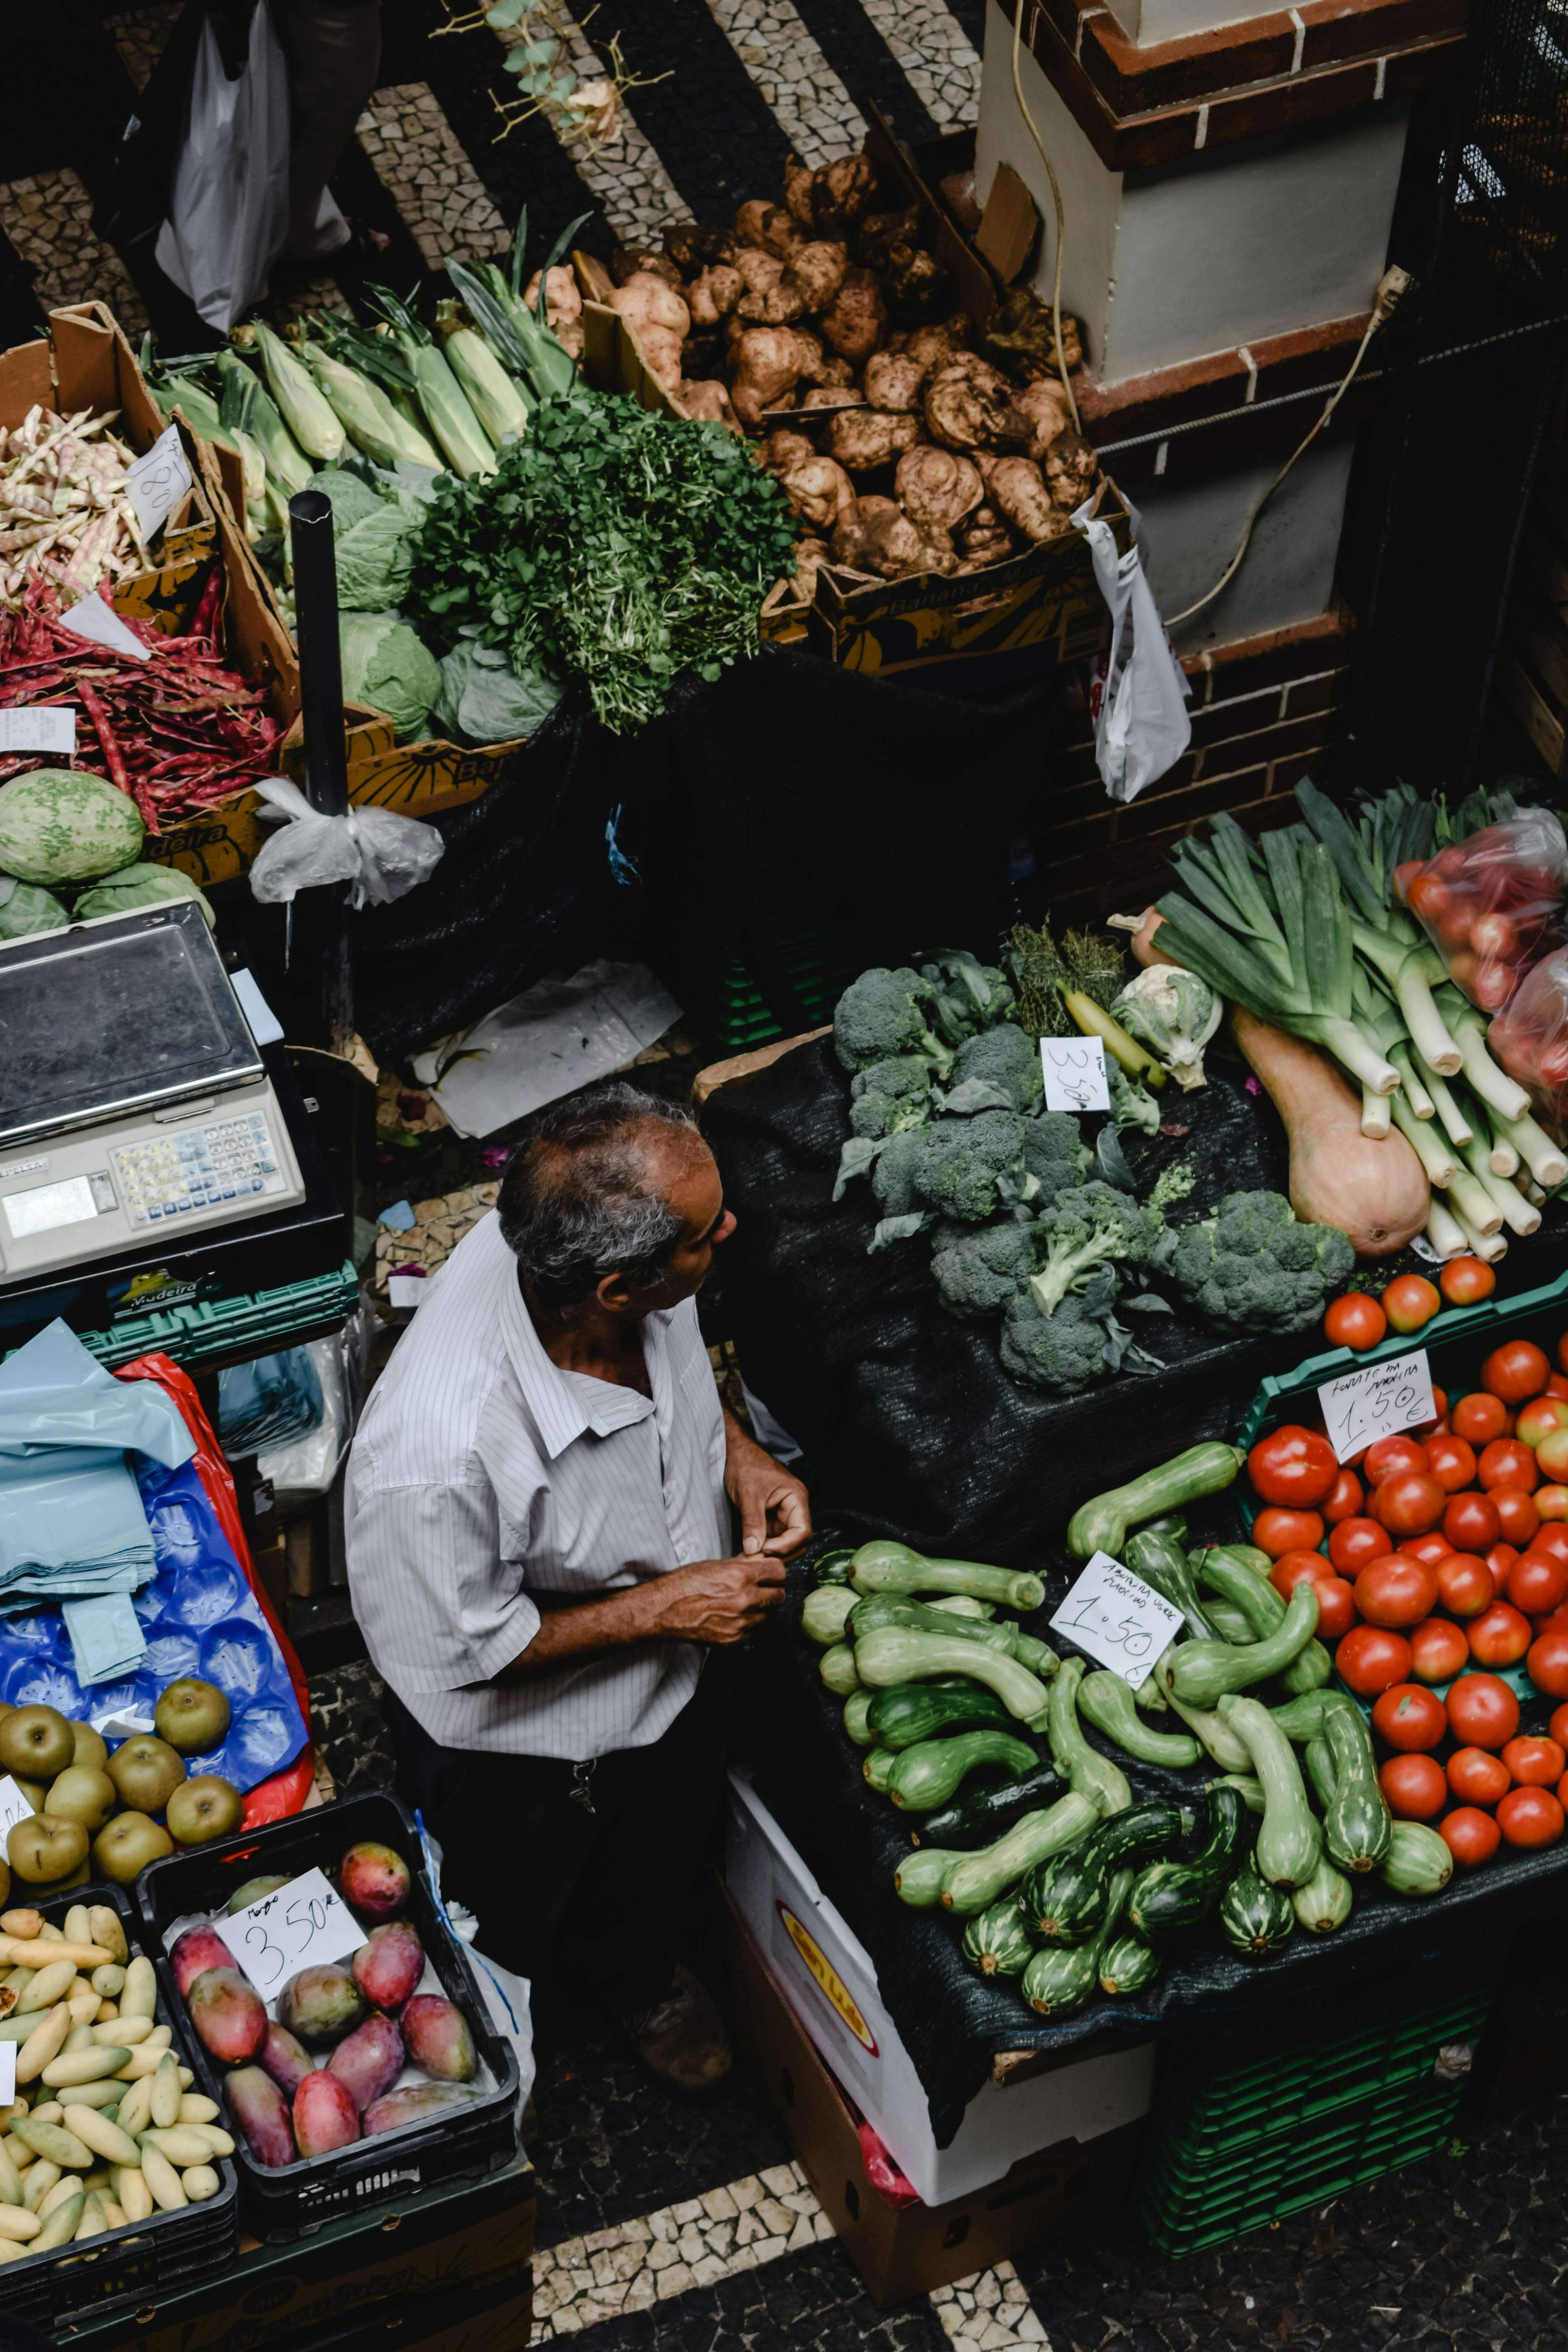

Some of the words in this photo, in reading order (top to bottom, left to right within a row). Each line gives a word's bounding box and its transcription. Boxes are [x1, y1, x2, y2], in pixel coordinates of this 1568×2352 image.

[889, 582, 979, 615] Banana
[1001, 554, 1078, 584] Madeir
[1338, 1386, 1415, 1453] 1.50
[1406, 1397, 1428, 1422] €
[245, 1899, 326, 1985] 3.50
